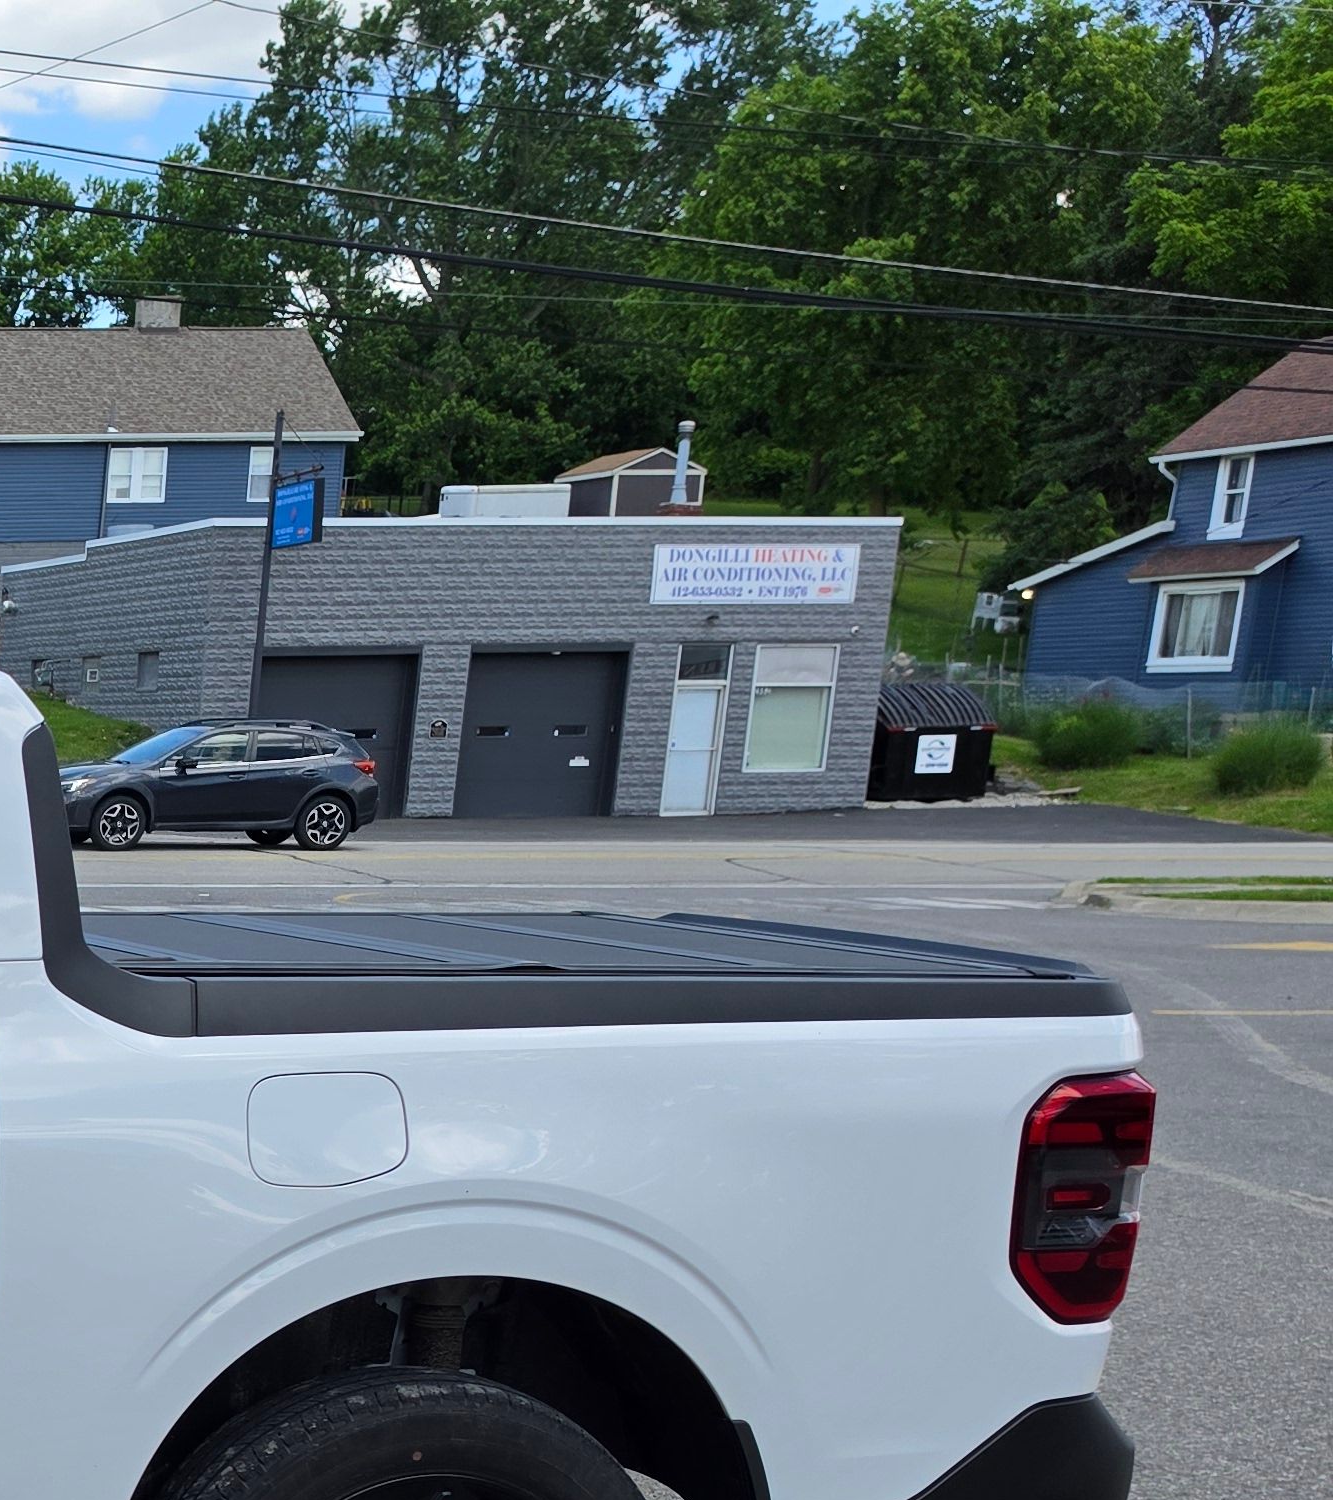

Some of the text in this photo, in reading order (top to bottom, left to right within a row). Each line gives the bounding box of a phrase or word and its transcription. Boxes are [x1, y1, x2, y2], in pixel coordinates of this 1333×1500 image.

[669, 548, 845, 563] DONGILLI HEATING &
[661, 566, 851, 582] AIR CONDITIONING, LLC
[758, 585, 781, 598] EST
